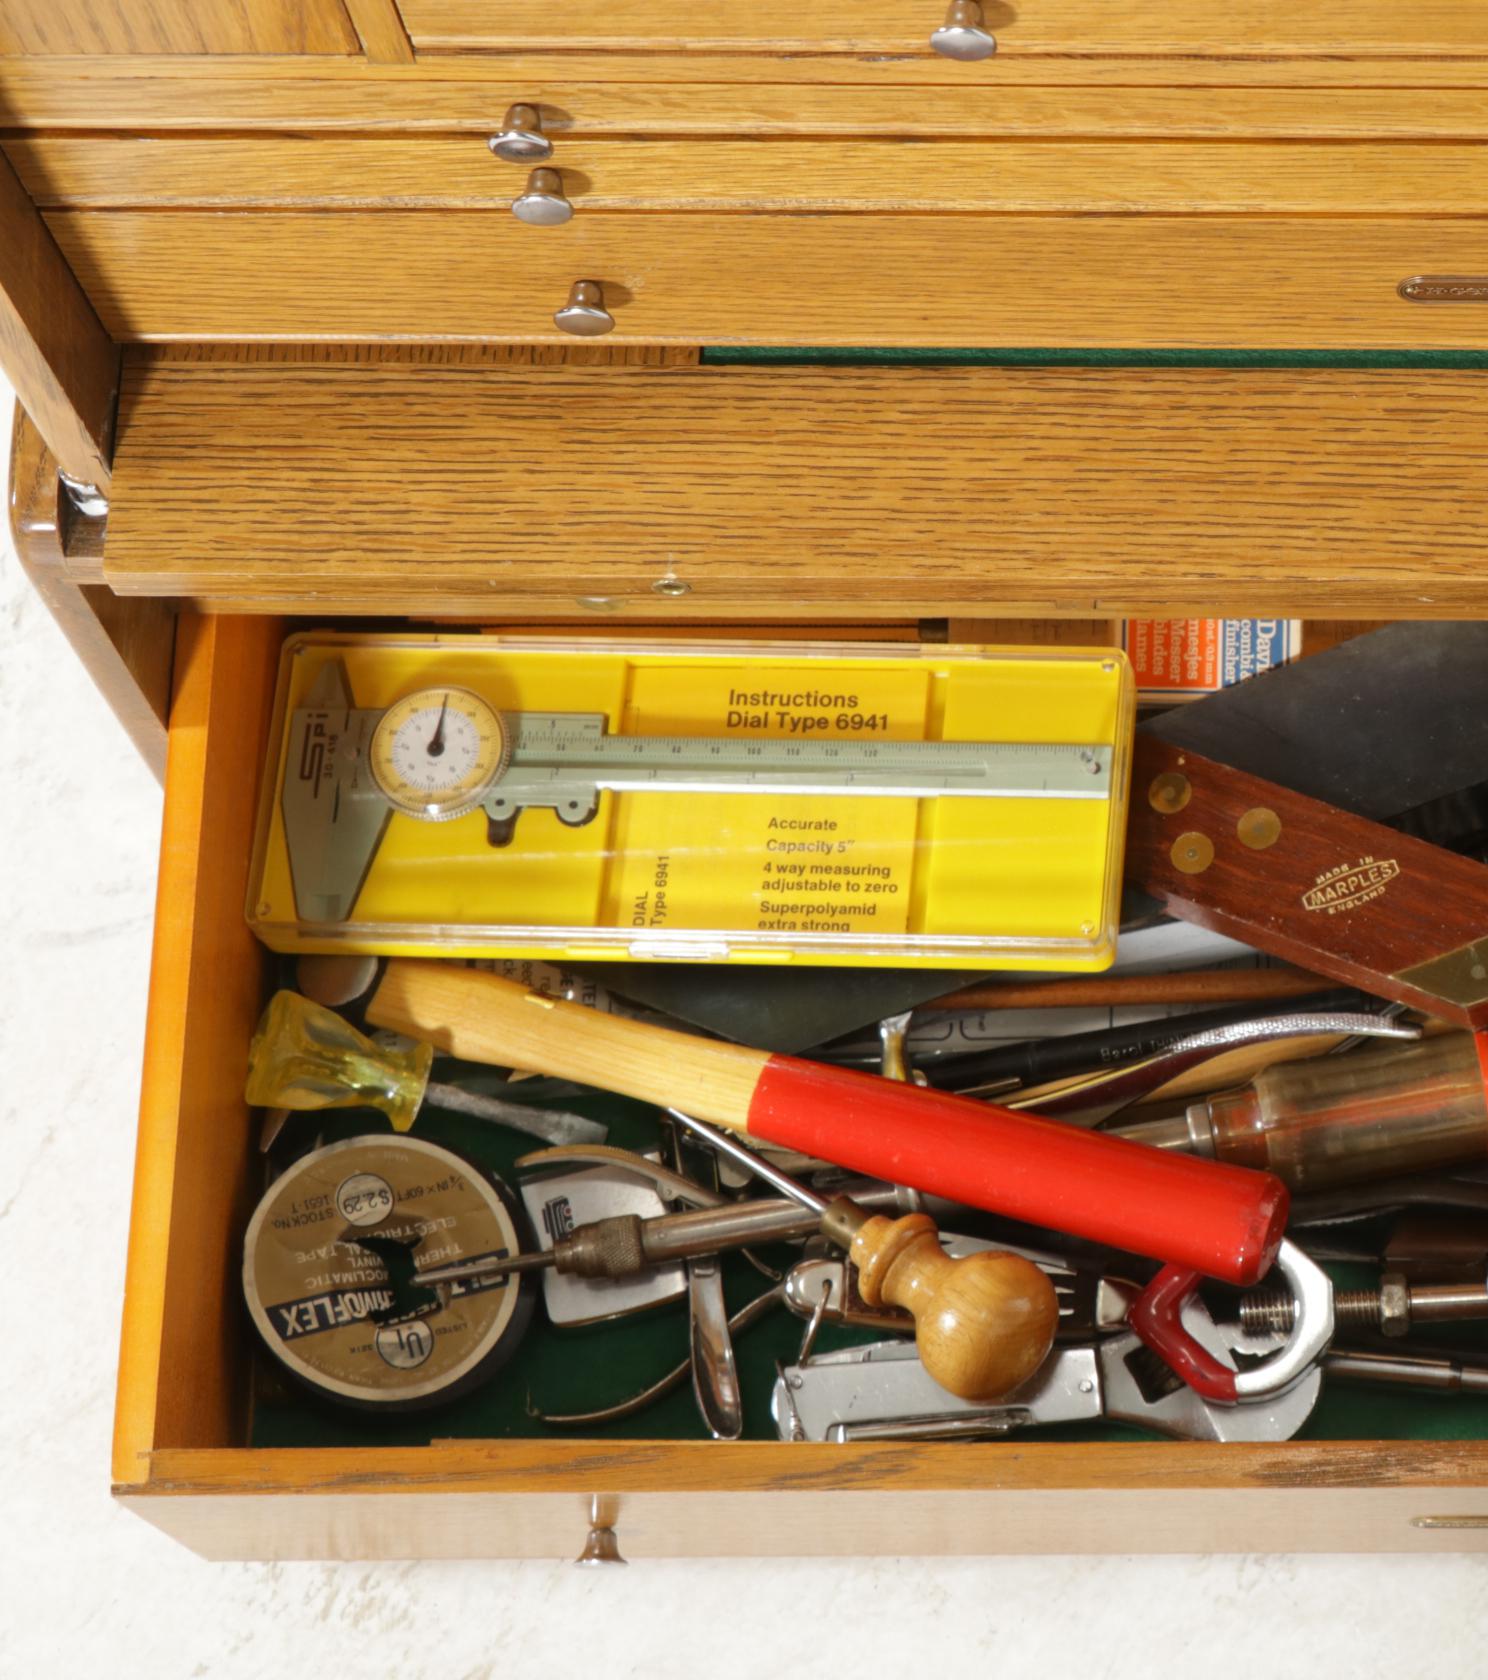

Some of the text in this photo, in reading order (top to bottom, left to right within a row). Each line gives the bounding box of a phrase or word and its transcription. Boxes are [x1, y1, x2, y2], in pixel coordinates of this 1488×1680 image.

[1153, 619, 1168, 675] blades
[1170, 619, 1185, 683] Messer
[1185, 619, 1201, 680] mesjes
[1225, 619, 1239, 683] finisher
[1240, 619, 1256, 668] combi
[1256, 619, 1276, 673] Davi
[729, 688, 859, 708] Instructions
[726, 711, 888, 732] Dial Type 6941
[767, 816, 838, 831] Accurate
[765, 838, 834, 856] Capacity
[763, 861, 892, 879] 4 way measuring
[1316, 855, 1374, 884] MADE IN
[649, 855, 670, 928] Type 6941
[761, 878, 899, 894] adjustable to zero
[1310, 862, 1393, 907] MARPLES
[632, 890, 649, 927] DIAL
[759, 900, 878, 917] Superpolyamid
[1327, 886, 1386, 914] ENGLAND
[757, 918, 851, 932] extra strong
[342, 1189, 391, 1215] $2.29
[296, 1246, 338, 1263] TAPE
